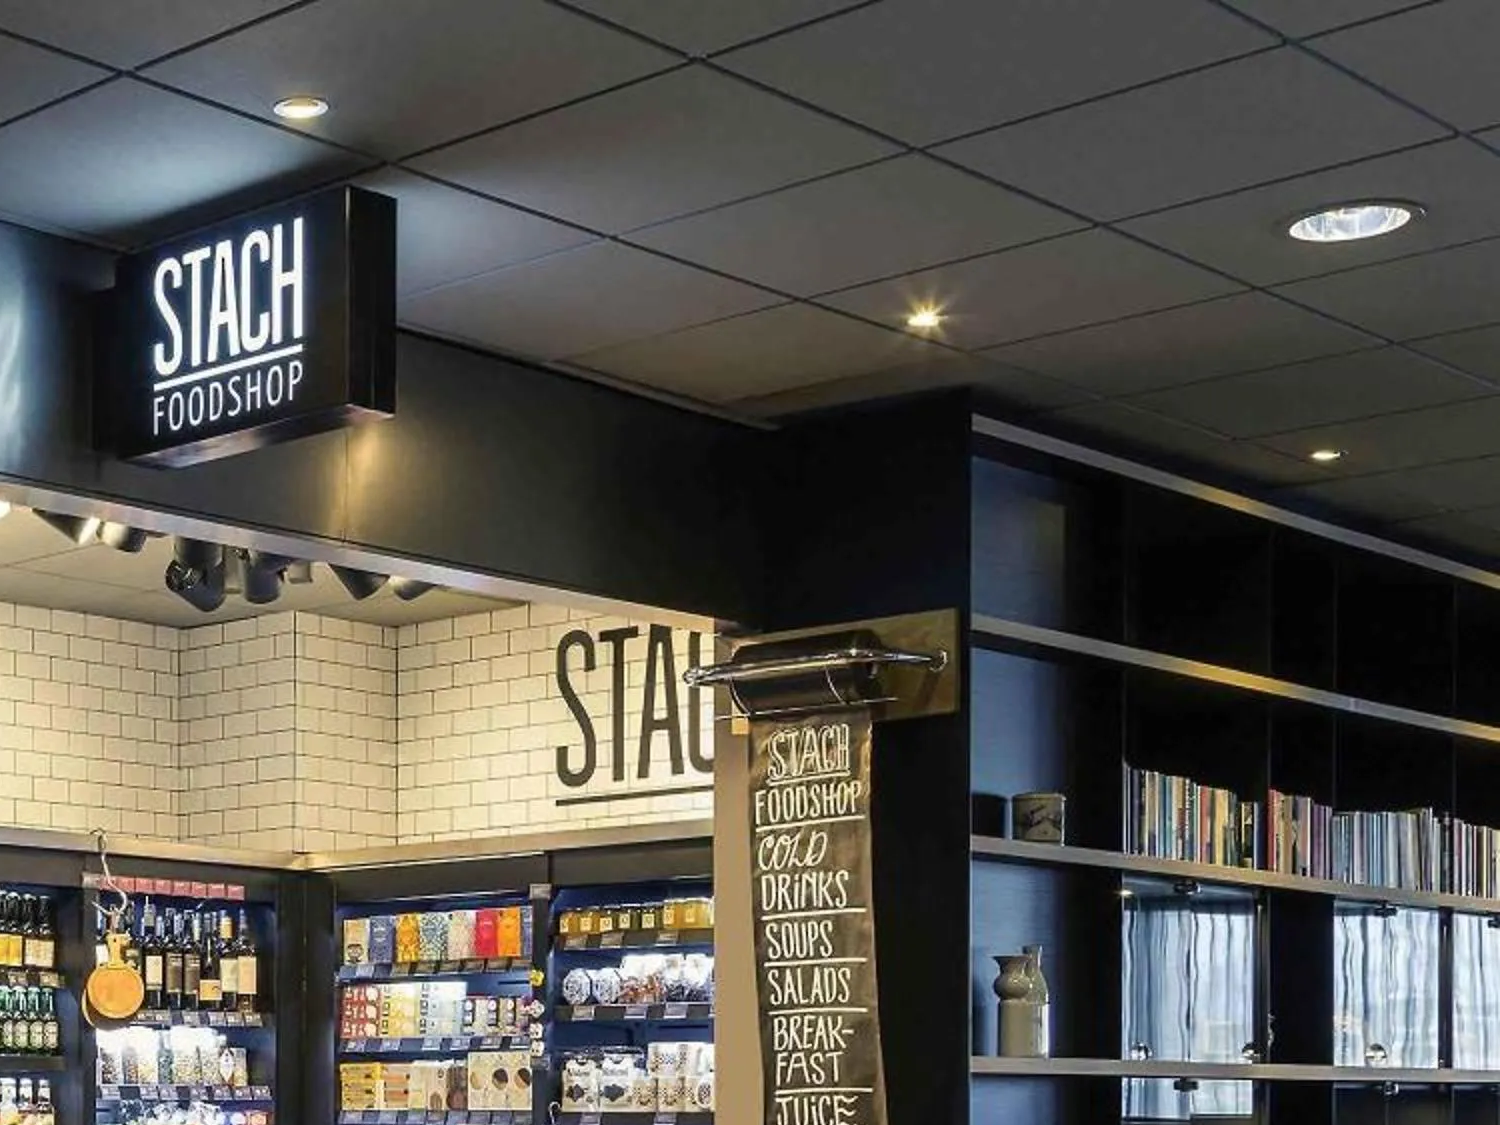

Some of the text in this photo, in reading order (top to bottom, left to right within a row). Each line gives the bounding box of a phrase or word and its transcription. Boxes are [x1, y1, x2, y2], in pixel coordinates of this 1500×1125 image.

[153, 216, 304, 377] STACH
[152, 360, 303, 436] FOODSHOP
[767, 723, 850, 780] STACH
[755, 780, 864, 826] FOODSHOP
[758, 831, 828, 871] COLD
[766, 919, 834, 962] SOUPS
[767, 966, 852, 1006] SALADS
[773, 1014, 855, 1053] BREAK-
[776, 1051, 844, 1088] FAST
